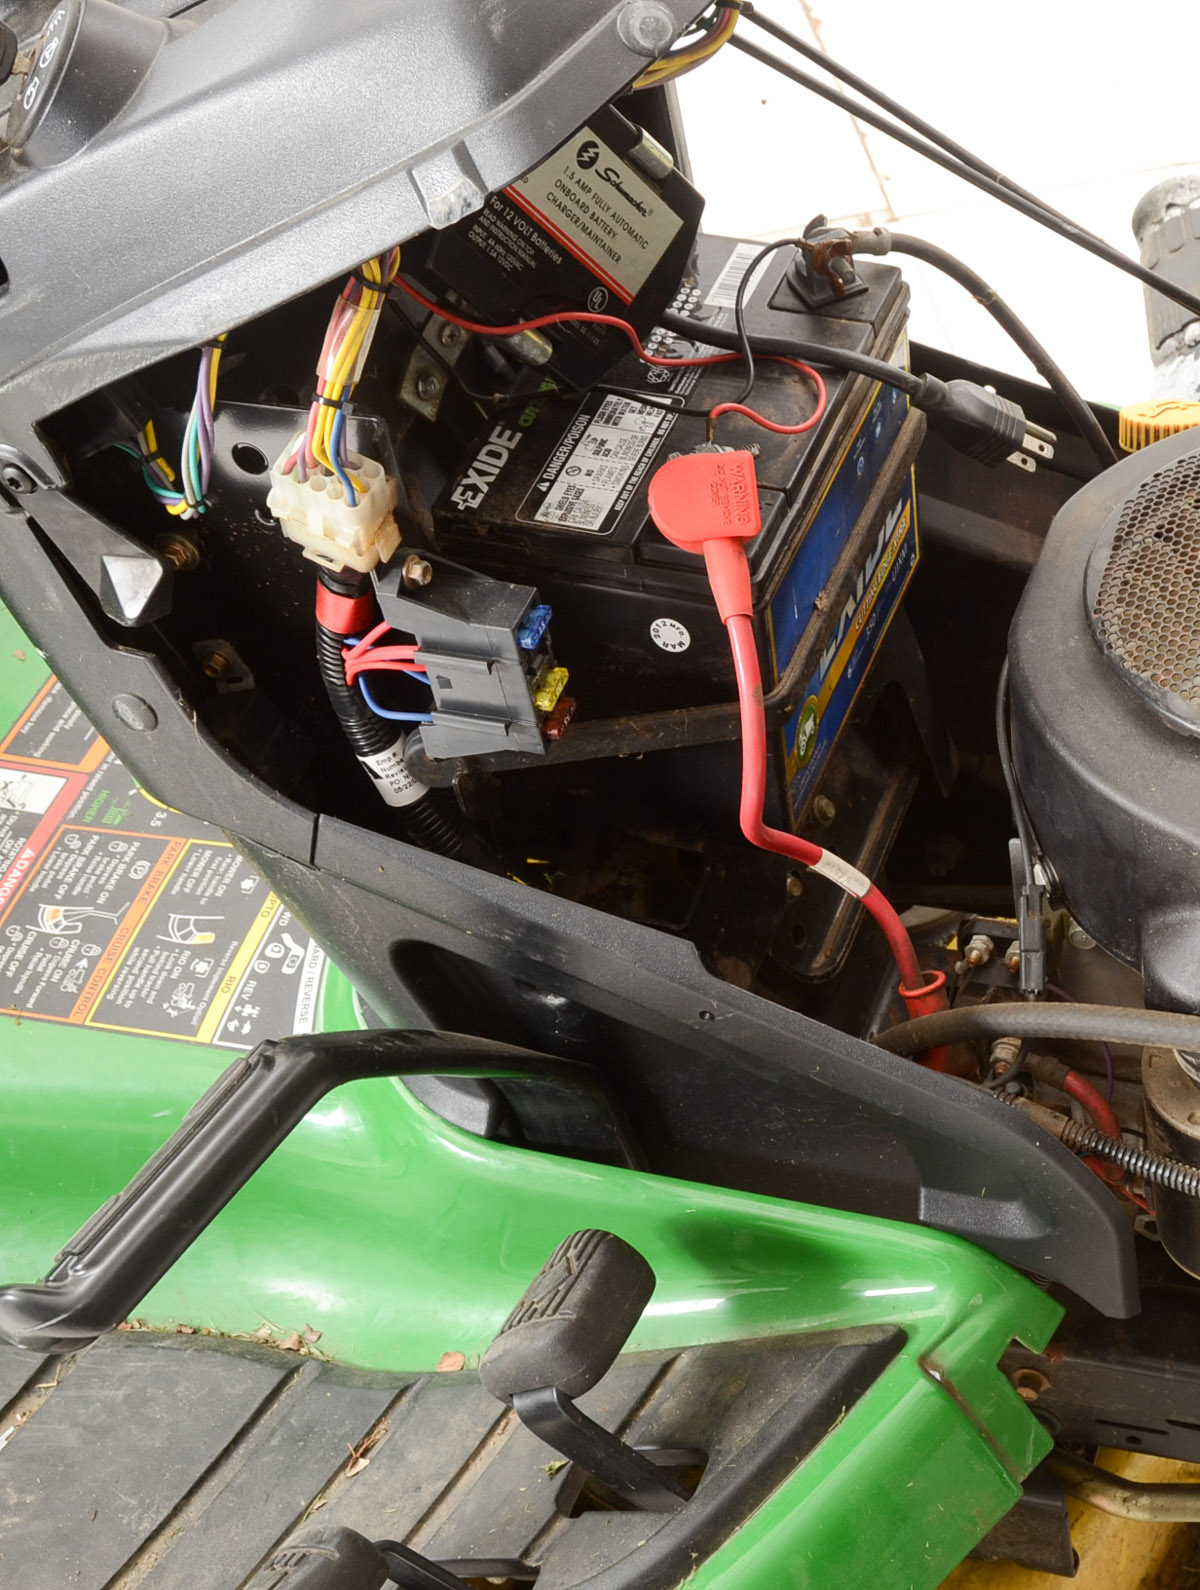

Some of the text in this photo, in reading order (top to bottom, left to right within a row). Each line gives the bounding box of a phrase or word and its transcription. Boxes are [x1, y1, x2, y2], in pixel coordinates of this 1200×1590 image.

[545, 188, 622, 266] CHARGER/MAINTAINER
[553, 177, 617, 241] ONBOARD BATTERY
[562, 164, 648, 250] 1.5 AMP FULLY AUTOMATIC
[489, 194, 563, 264] For 12 VOLT Batteries
[593, 400, 613, 423] FLUSH EYES
[541, 412, 591, 480] DANGER/POISON
[448, 423, 524, 510] EXIDE
[583, 468, 594, 477] NO
[553, 484, 576, 511] SHIELD EYES
[570, 487, 585, 501] GASES
[728, 462, 752, 524] WARNING
[652, 620, 668, 638] 2012
[662, 640, 686, 649] MAR
[380, 758, 404, 772] Numbe
[80, 789, 111, 823] HIGHER
[150, 810, 168, 828] 3.5
[26, 870, 48, 892] handle
[52, 834, 100, 900] PARK BRAKE OFF
[69, 873, 91, 896] handle
[80, 857, 111, 894] brake pedal
[94, 841, 141, 904] PARK BRAKE ON
[136, 840, 181, 903] PARK BRAKE
[167, 872, 188, 895] handle
[180, 849, 213, 893] MOWER OFF
[192, 869, 214, 895] position
[202, 875, 221, 896] handle
[213, 854, 244, 897] MOWER ON
[2, 930, 38, 978] CRUISE OFF
[48, 938, 81, 982] CRUISE ON
[71, 926, 131, 1018] CRUISE CONTROL
[103, 947, 143, 1000] while reversing
[145, 949, 162, 964] Pull
[168, 950, 192, 979] RIO ON
[112, 947, 152, 1005] second position
[131, 964, 153, 988] handle
[136, 951, 171, 998] behind tractor
[143, 952, 179, 1004] Look down and
[218, 975, 237, 994] RIO
[238, 979, 258, 1000] REV
[298, 976, 314, 1024] REVERSE
